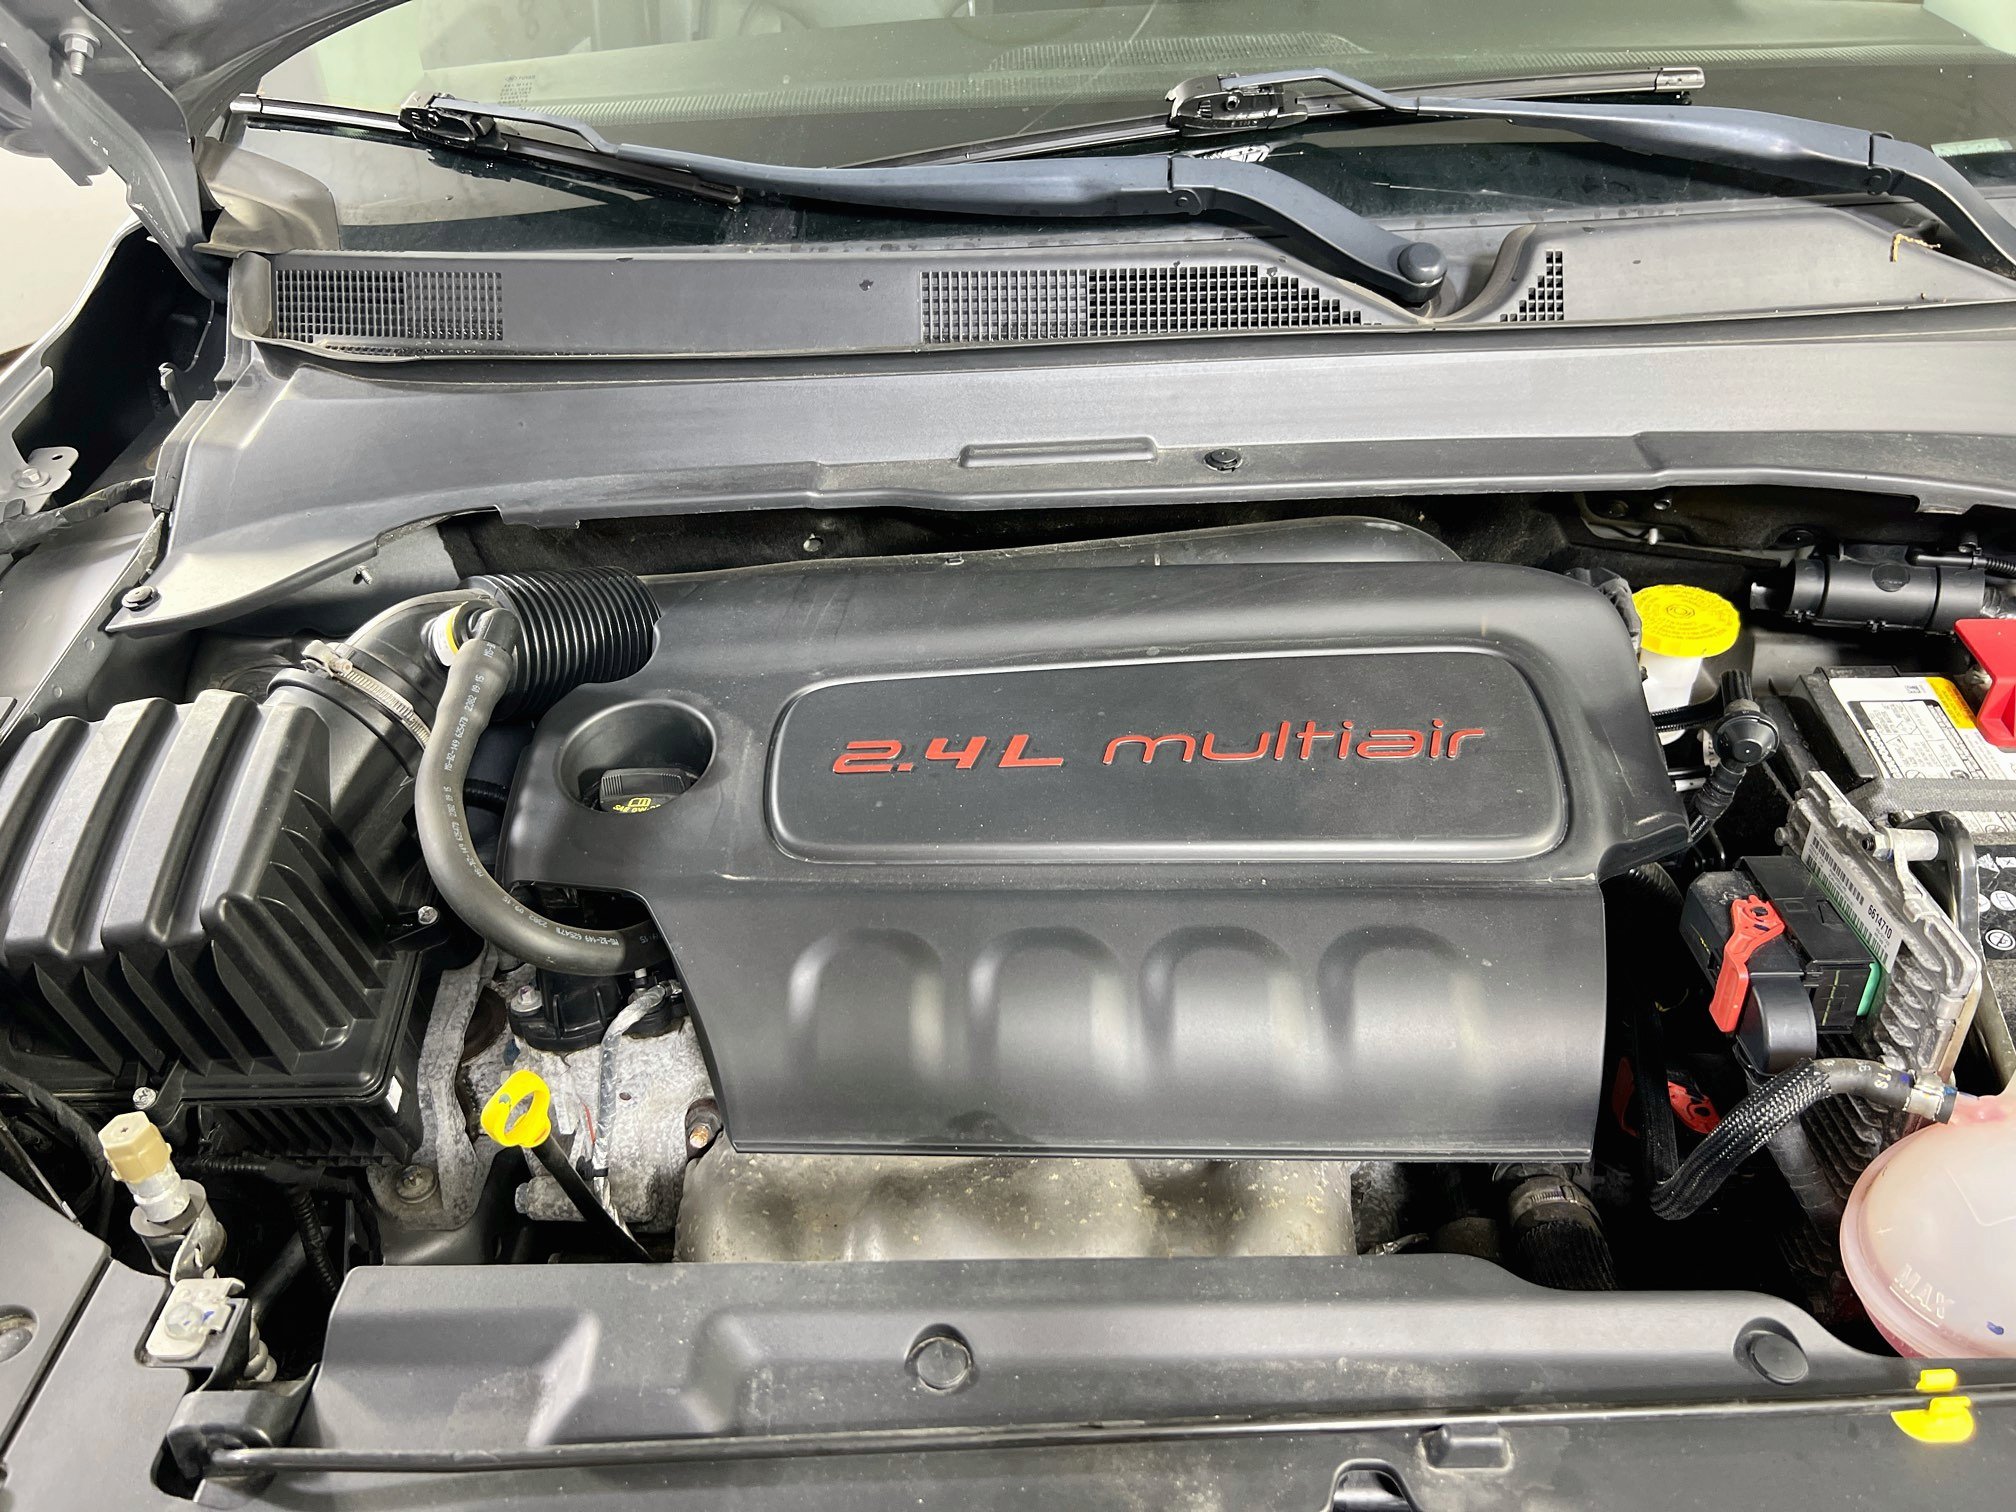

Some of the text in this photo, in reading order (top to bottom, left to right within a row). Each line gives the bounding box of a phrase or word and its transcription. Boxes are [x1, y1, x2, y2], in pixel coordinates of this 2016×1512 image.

[1102, 720, 1486, 765] multiair
[1867, 904, 1893, 940] 6614710
[1893, 1262, 1956, 1321] MAX
